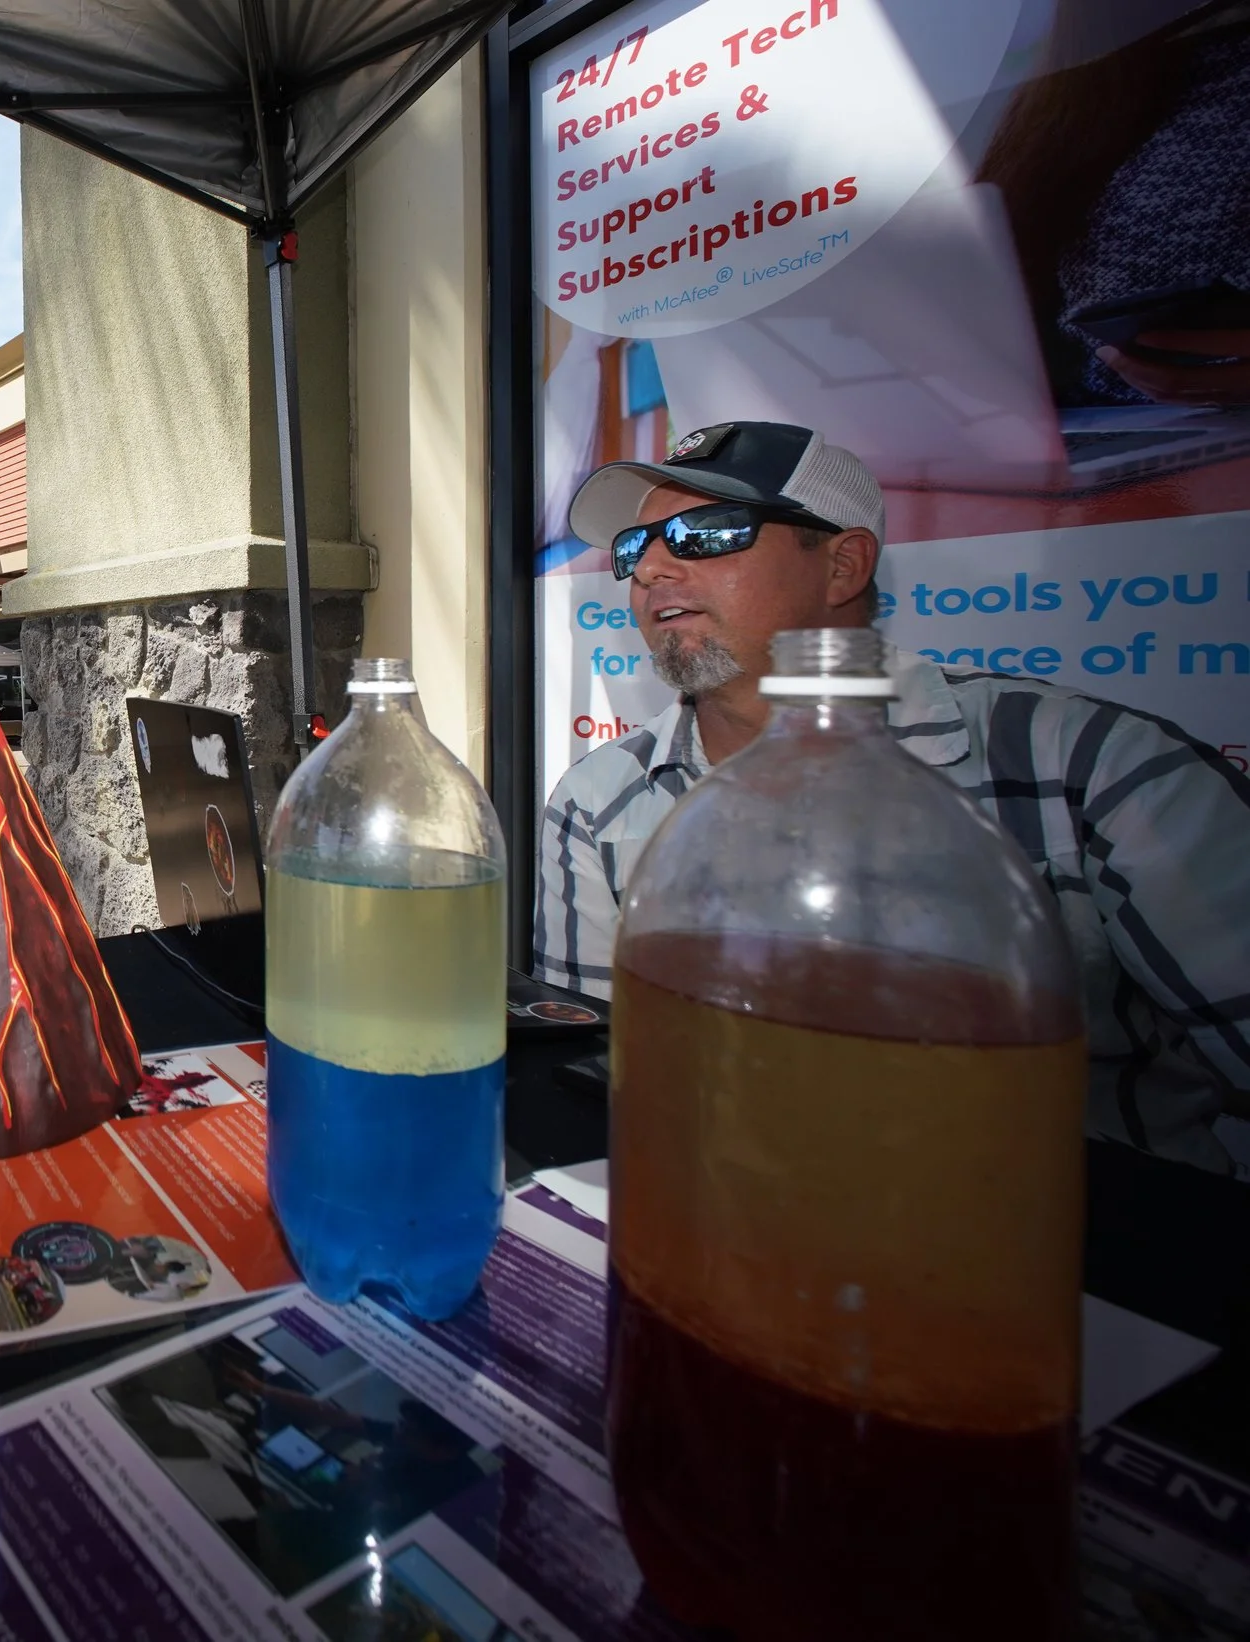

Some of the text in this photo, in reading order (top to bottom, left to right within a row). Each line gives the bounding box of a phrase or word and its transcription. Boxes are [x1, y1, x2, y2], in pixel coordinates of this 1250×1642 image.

[556, 24, 649, 103] 24/7
[557, 0, 839, 153] Remote Tech
[556, 84, 770, 202] Services &
[556, 164, 716, 252] Support
[556, 176, 859, 302] Subscriptions
[618, 304, 651, 325] with
[576, 601, 639, 631] Get
[910, 572, 1063, 616] tools
[1079, 572, 1218, 622] you
[590, 646, 641, 676] for
[916, 645, 1062, 676] eace
[1080, 631, 1156, 676] of
